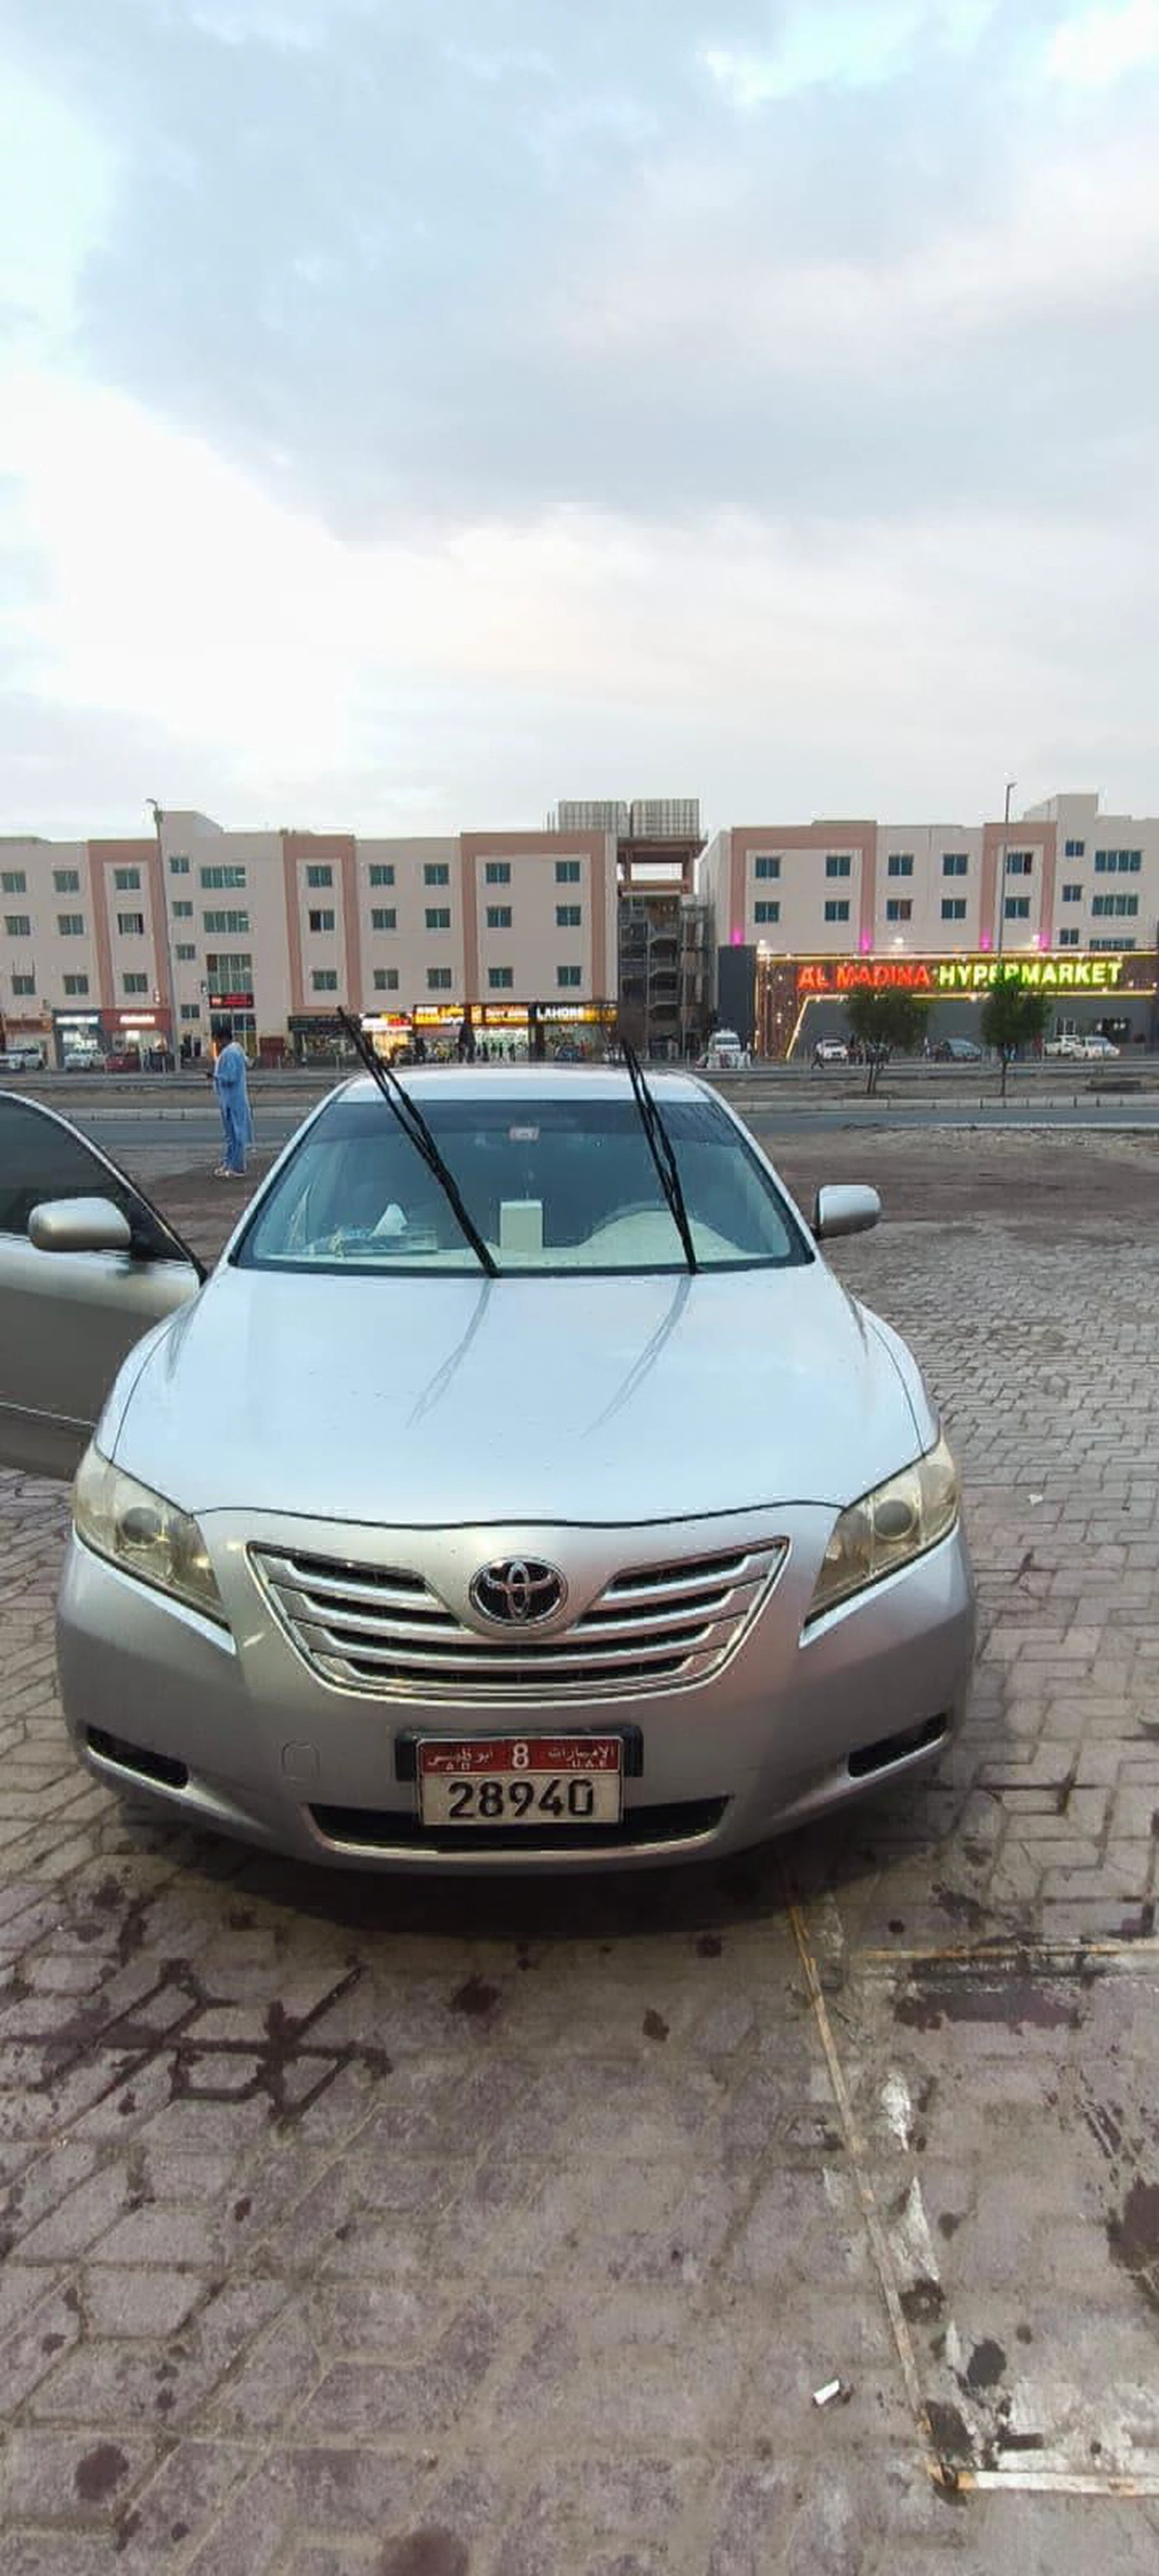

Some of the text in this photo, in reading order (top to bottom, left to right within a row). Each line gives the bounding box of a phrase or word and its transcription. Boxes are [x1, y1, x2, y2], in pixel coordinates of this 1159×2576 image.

[798, 966, 828, 989] AL
[835, 964, 930, 987] MADINA
[512, 1742, 529, 1769] 8
[447, 1779, 594, 1818] 28940
